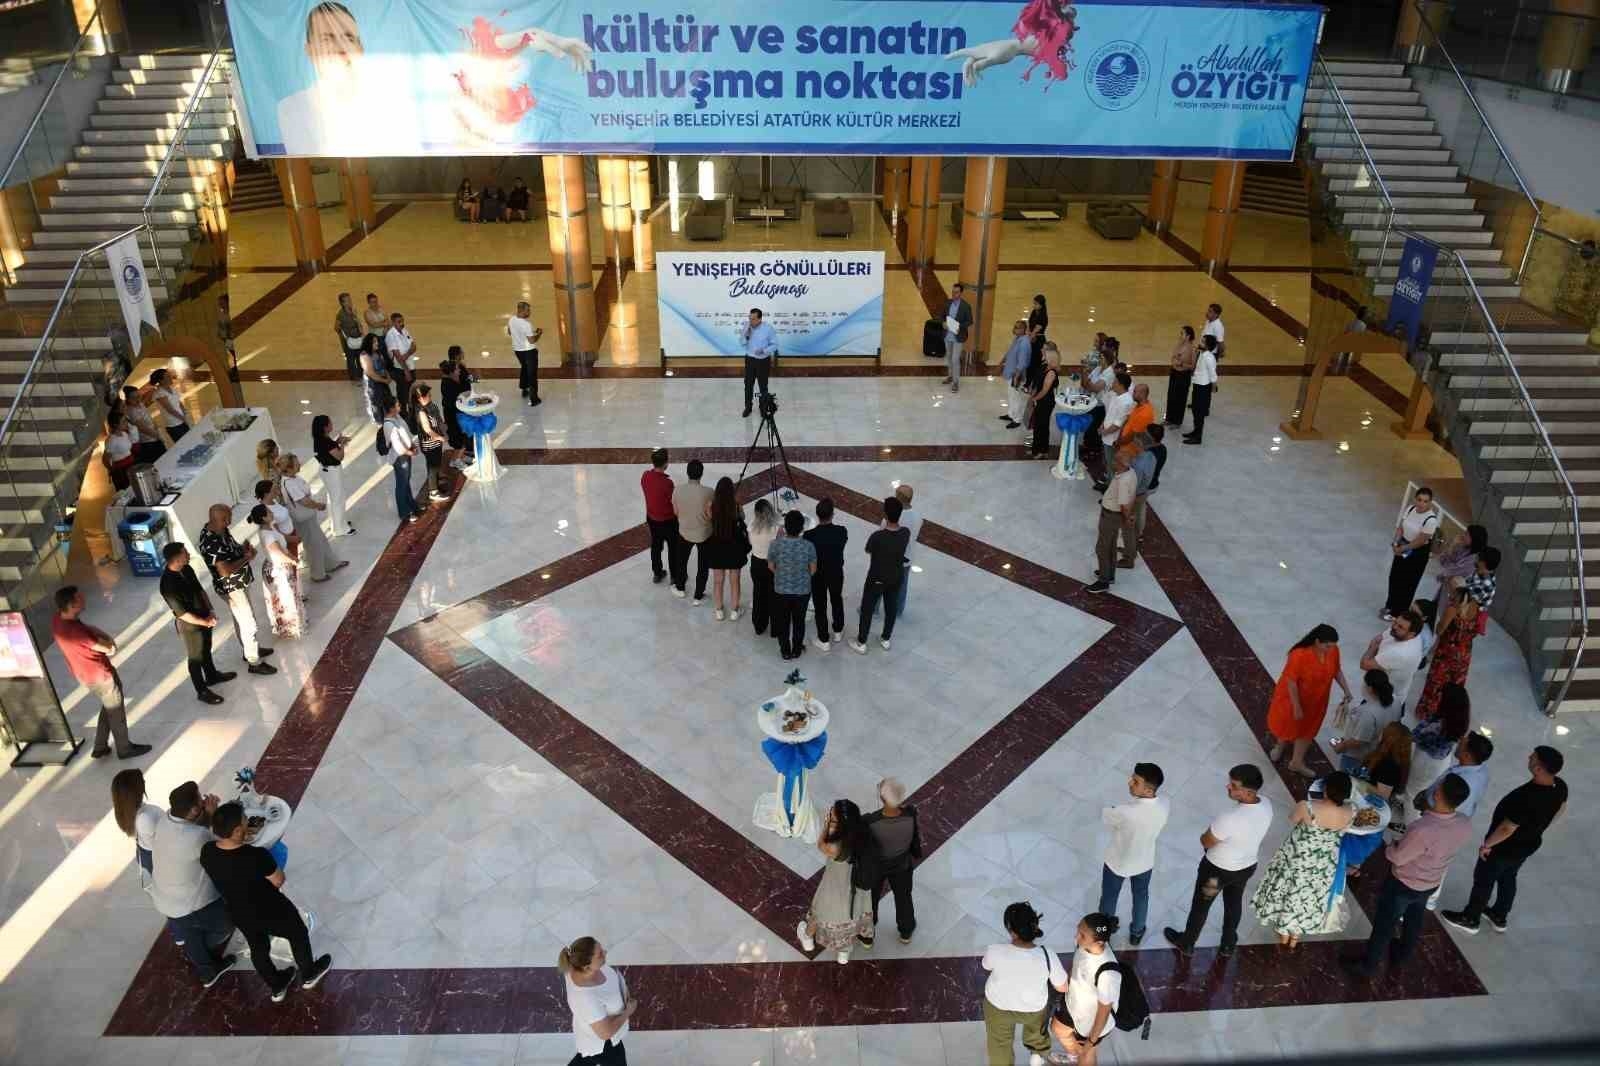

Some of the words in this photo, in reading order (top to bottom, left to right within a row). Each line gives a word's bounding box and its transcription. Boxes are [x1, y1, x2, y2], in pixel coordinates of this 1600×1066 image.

[582, 12, 719, 54] kültür
[731, 25, 785, 54] ve
[795, 20, 967, 56] sanatın
[1197, 44, 1283, 72] Abdullah
[587, 58, 784, 109] buluşma
[793, 61, 964, 100] noktası
[591, 112, 669, 130] YENİŞEHİR
[674, 111, 759, 128] BELEDİYESİ
[764, 111, 832, 128] ATATÜRK
[837, 110, 893, 128] KÜLTÜR
[898, 111, 961, 129] MERKEZİ
[672, 262, 755, 280] YENİŞEHİR
[760, 259, 871, 277] GÖNÜLLÜLERİ
[729, 277, 809, 299] Buluşması
